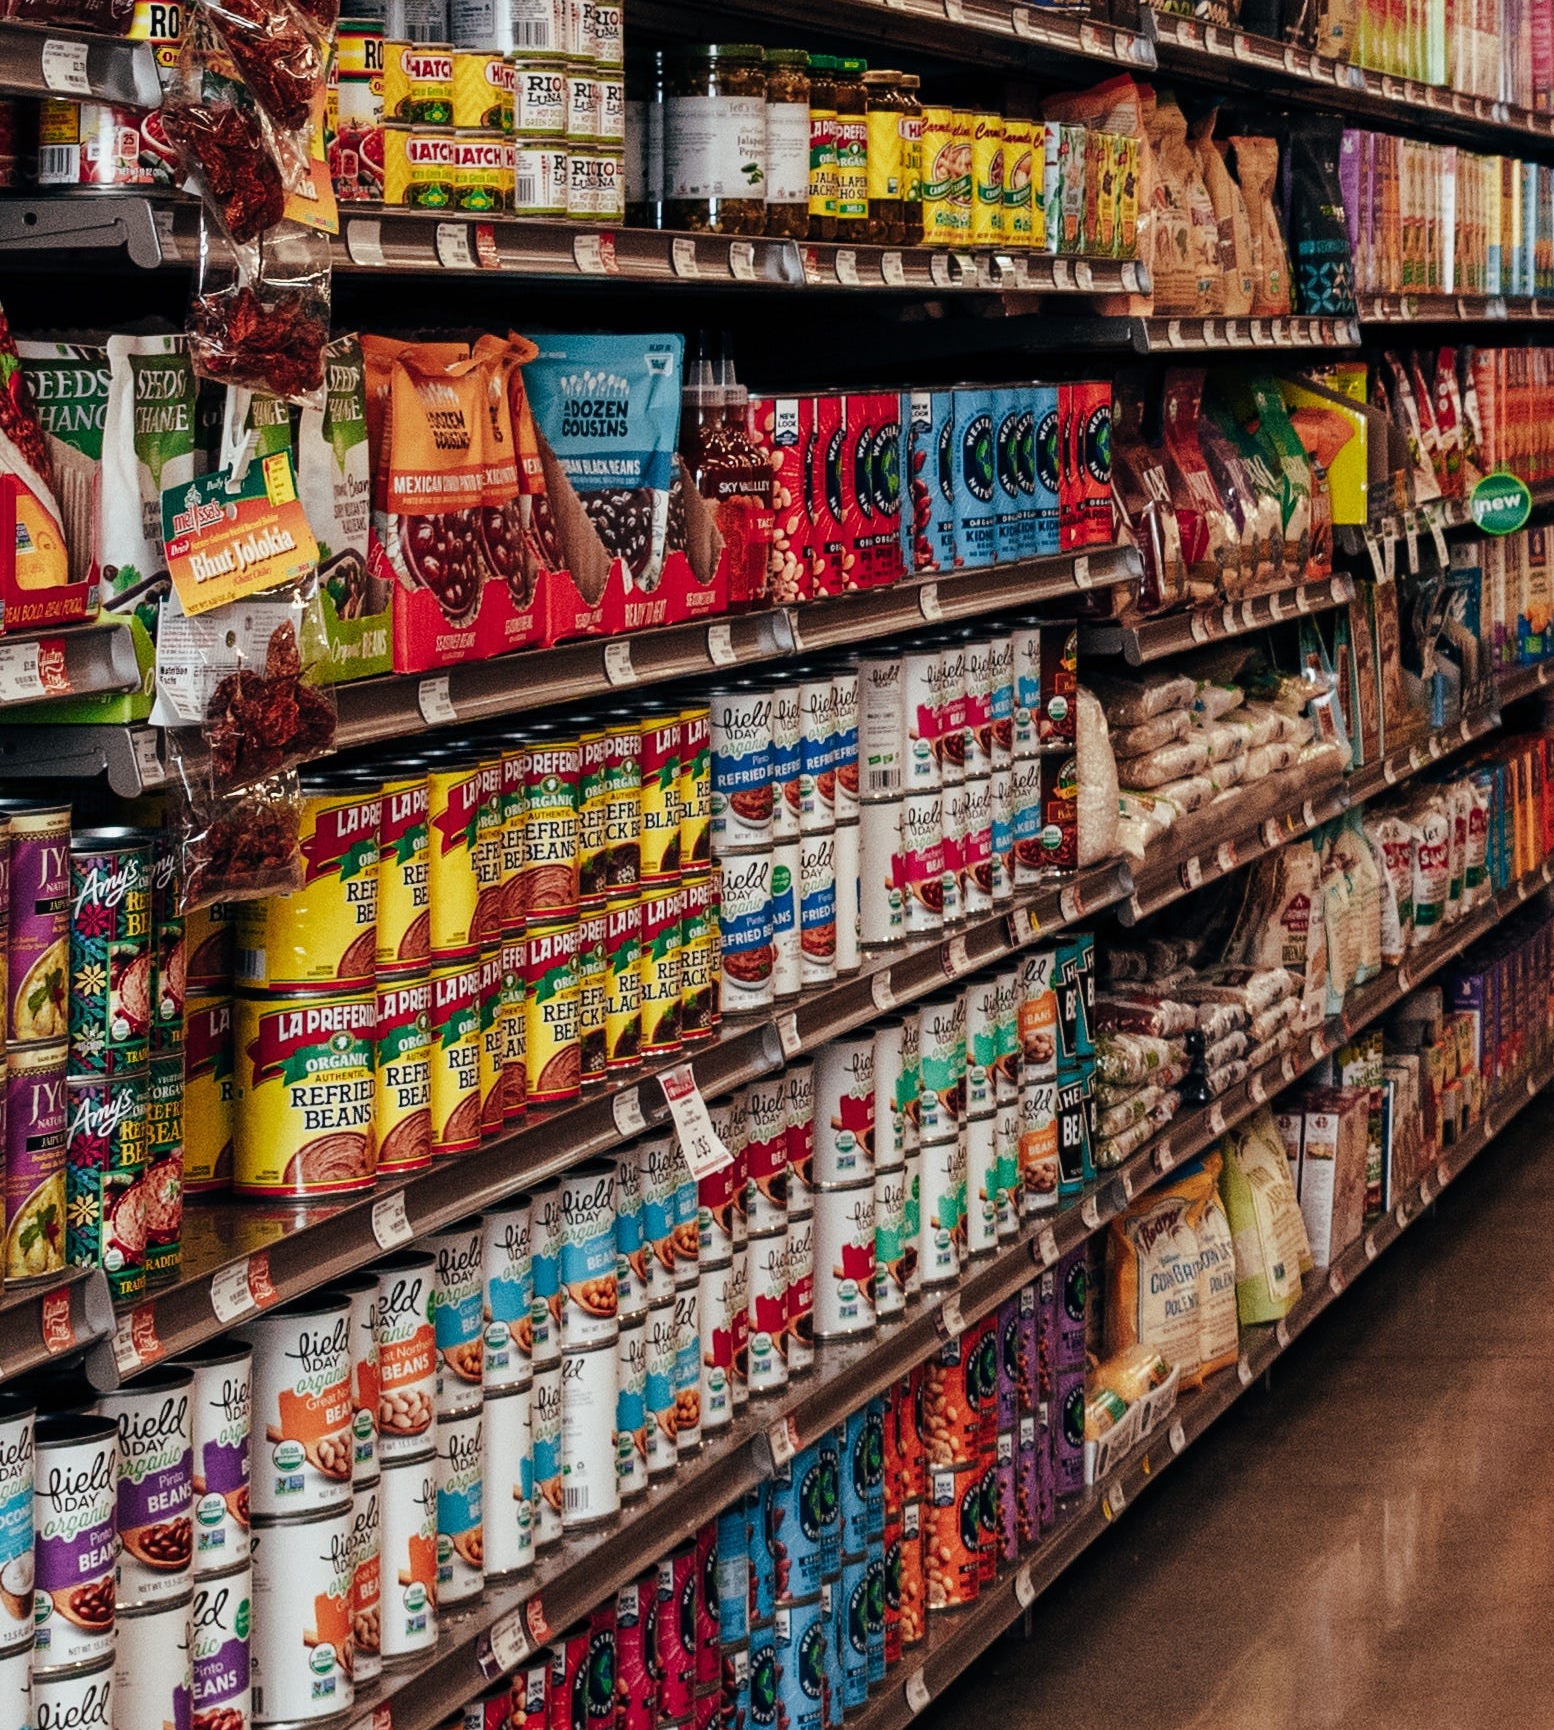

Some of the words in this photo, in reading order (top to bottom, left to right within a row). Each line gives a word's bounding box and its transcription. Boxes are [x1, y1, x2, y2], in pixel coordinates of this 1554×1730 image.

[571, 400, 629, 421] DOZEN
[778, 412, 797, 422] NEW
[561, 418, 629, 439] COUSINS
[777, 420, 798, 430] LOOK
[393, 473, 442, 496] MEXICAN
[719, 481, 739, 496] SKY
[1474, 493, 1521, 514] new
[172, 498, 226, 538] melissa's
[188, 540, 236, 583] Bhut
[236, 524, 297, 573] Jolokia
[711, 699, 772, 735] field
[733, 726, 761, 740] DAY
[717, 767, 764, 788] REFRIED
[73, 858, 138, 920] Amy's
[278, 1014, 304, 1041] LA
[305, 1052, 370, 1072] ORGANIC
[315, 1069, 366, 1082] AUTHENTIC
[290, 1082, 375, 1108] REFRIED
[68, 1089, 133, 1150] Amy's
[304, 1104, 372, 1130] BEANS
[117, 1397, 188, 1448] field
[132, 1436, 169, 1457] DAY
